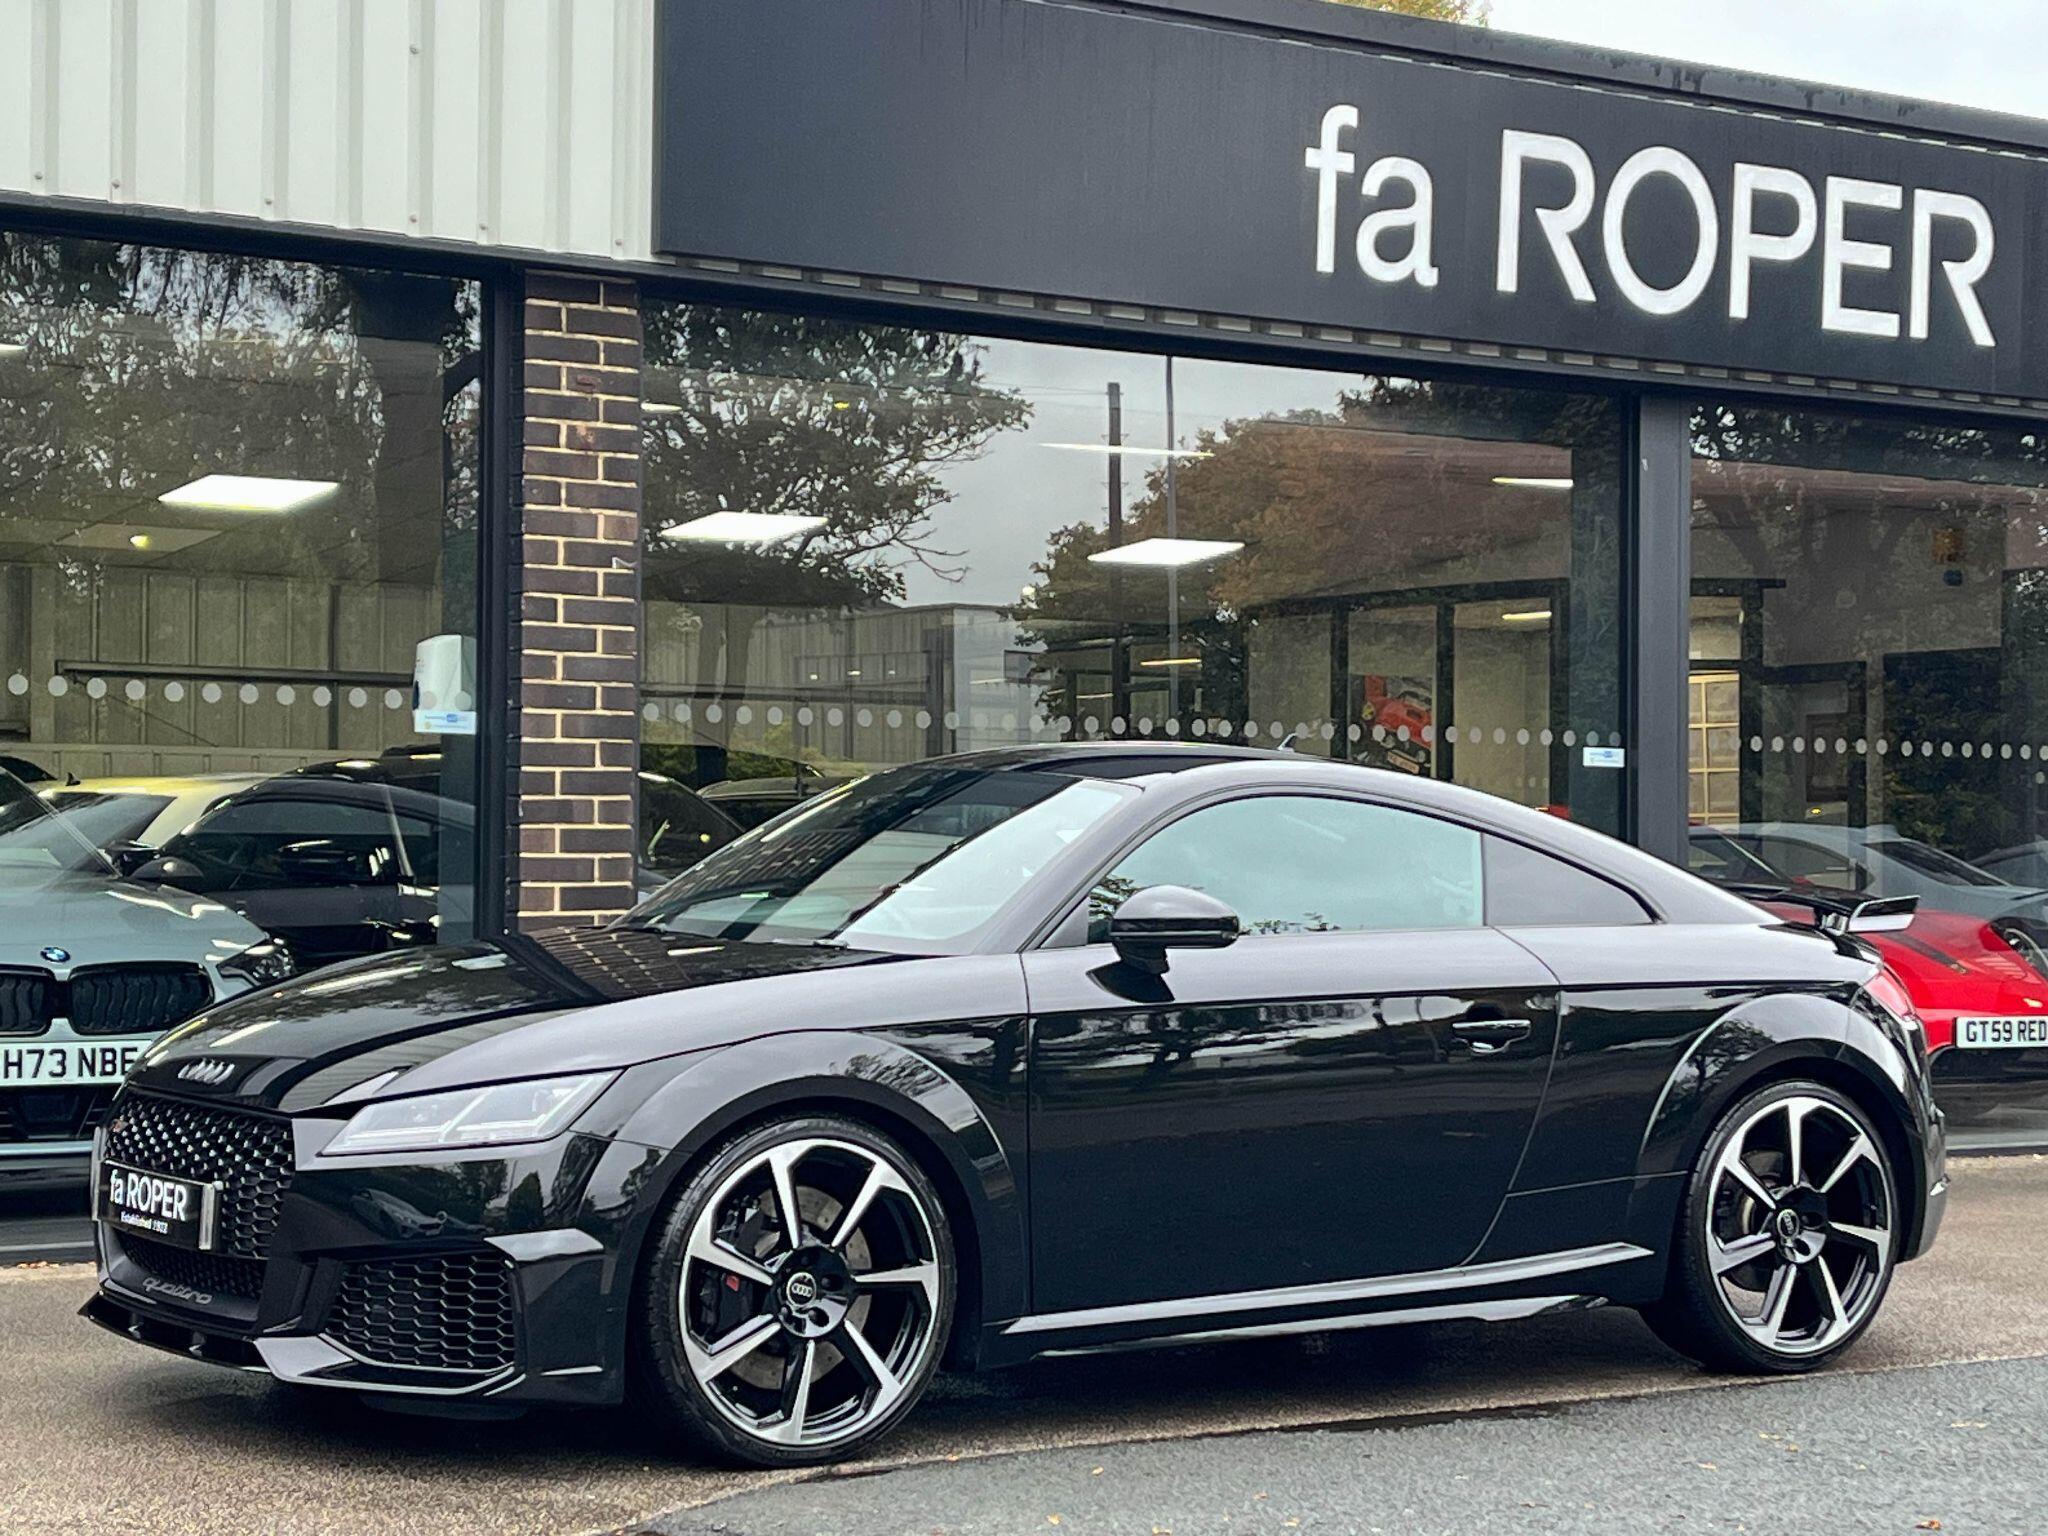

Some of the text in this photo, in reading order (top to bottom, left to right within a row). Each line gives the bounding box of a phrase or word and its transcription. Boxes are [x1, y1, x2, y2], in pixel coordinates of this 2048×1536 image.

[1304, 104, 1997, 347] fa ROPER
[1966, 1020, 2047, 1042] GT59 RED
[4, 1048, 66, 1079] H73
[110, 1169, 187, 1221] fa ROPER
[142, 1277, 212, 1304] quattro
